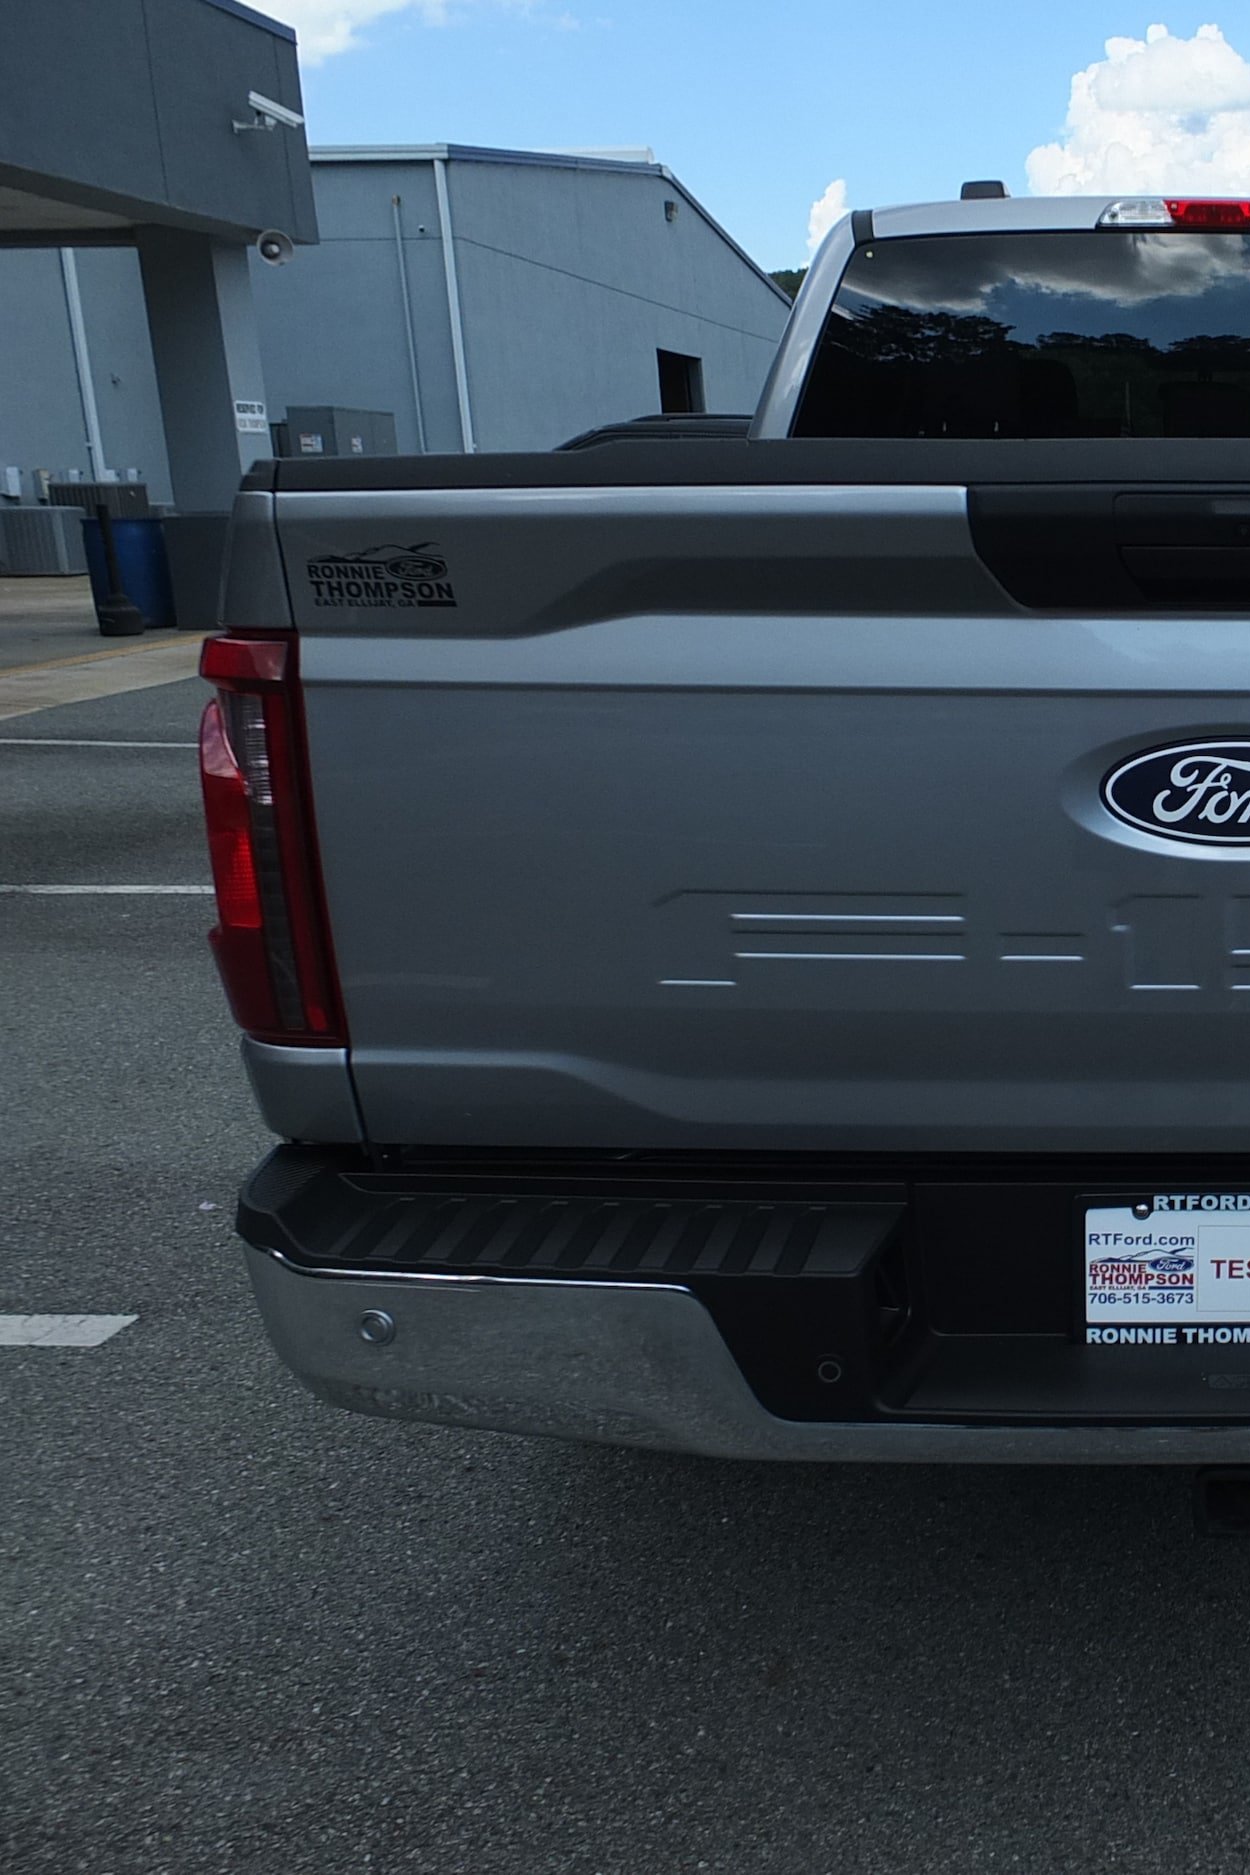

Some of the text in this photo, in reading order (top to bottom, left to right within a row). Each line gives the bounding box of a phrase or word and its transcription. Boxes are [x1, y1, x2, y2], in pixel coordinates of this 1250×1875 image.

[307, 565, 385, 580] RONNIE
[310, 581, 454, 599] THOMPSON
[314, 598, 344, 607] EAST
[1088, 1233, 1195, 1246] RTFord.com
[1089, 1263, 1147, 1274] RONNIE
[1156, 1258, 1186, 1271] Ford
[1089, 1273, 1194, 1285] THOMPSON
[1088, 1292, 1194, 1304] 706-515-3673
[1086, 1328, 1177, 1344] RONNIE
